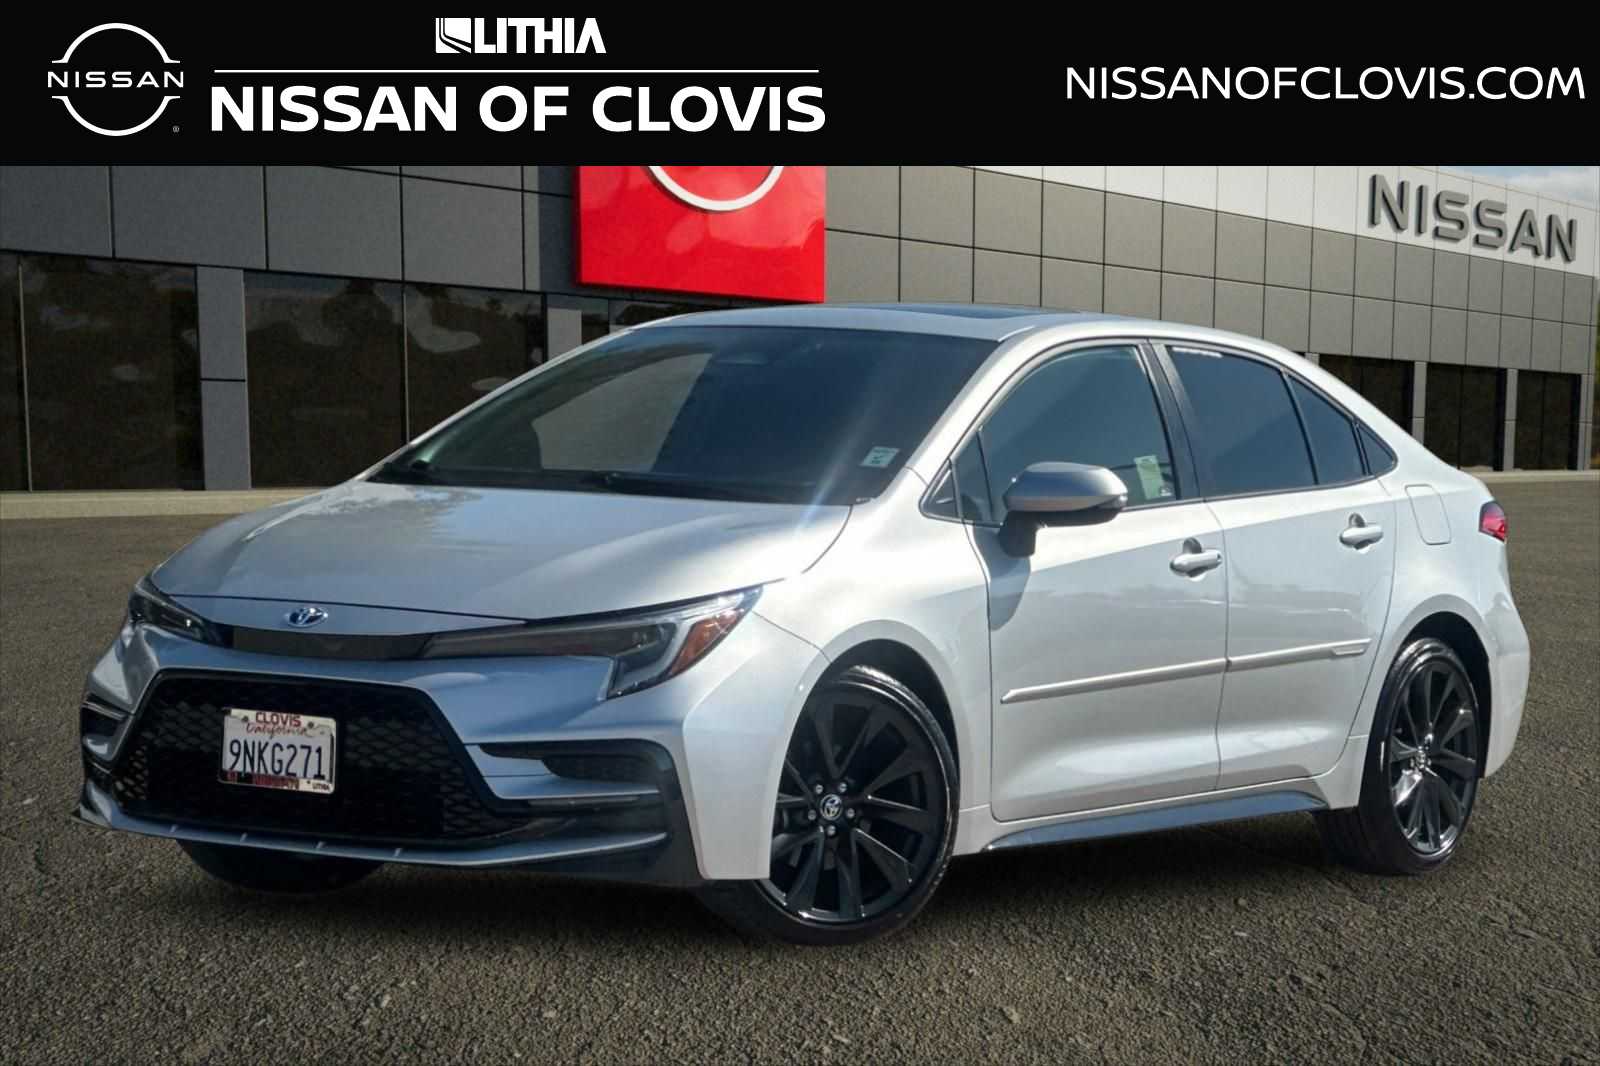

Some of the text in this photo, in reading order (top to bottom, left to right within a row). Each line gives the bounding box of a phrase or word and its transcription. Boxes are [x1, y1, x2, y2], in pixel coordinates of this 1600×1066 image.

[1368, 173, 1577, 264] NISSAN
[255, 711, 302, 728] CLOVIS
[229, 739, 325, 780] 9NKG271
